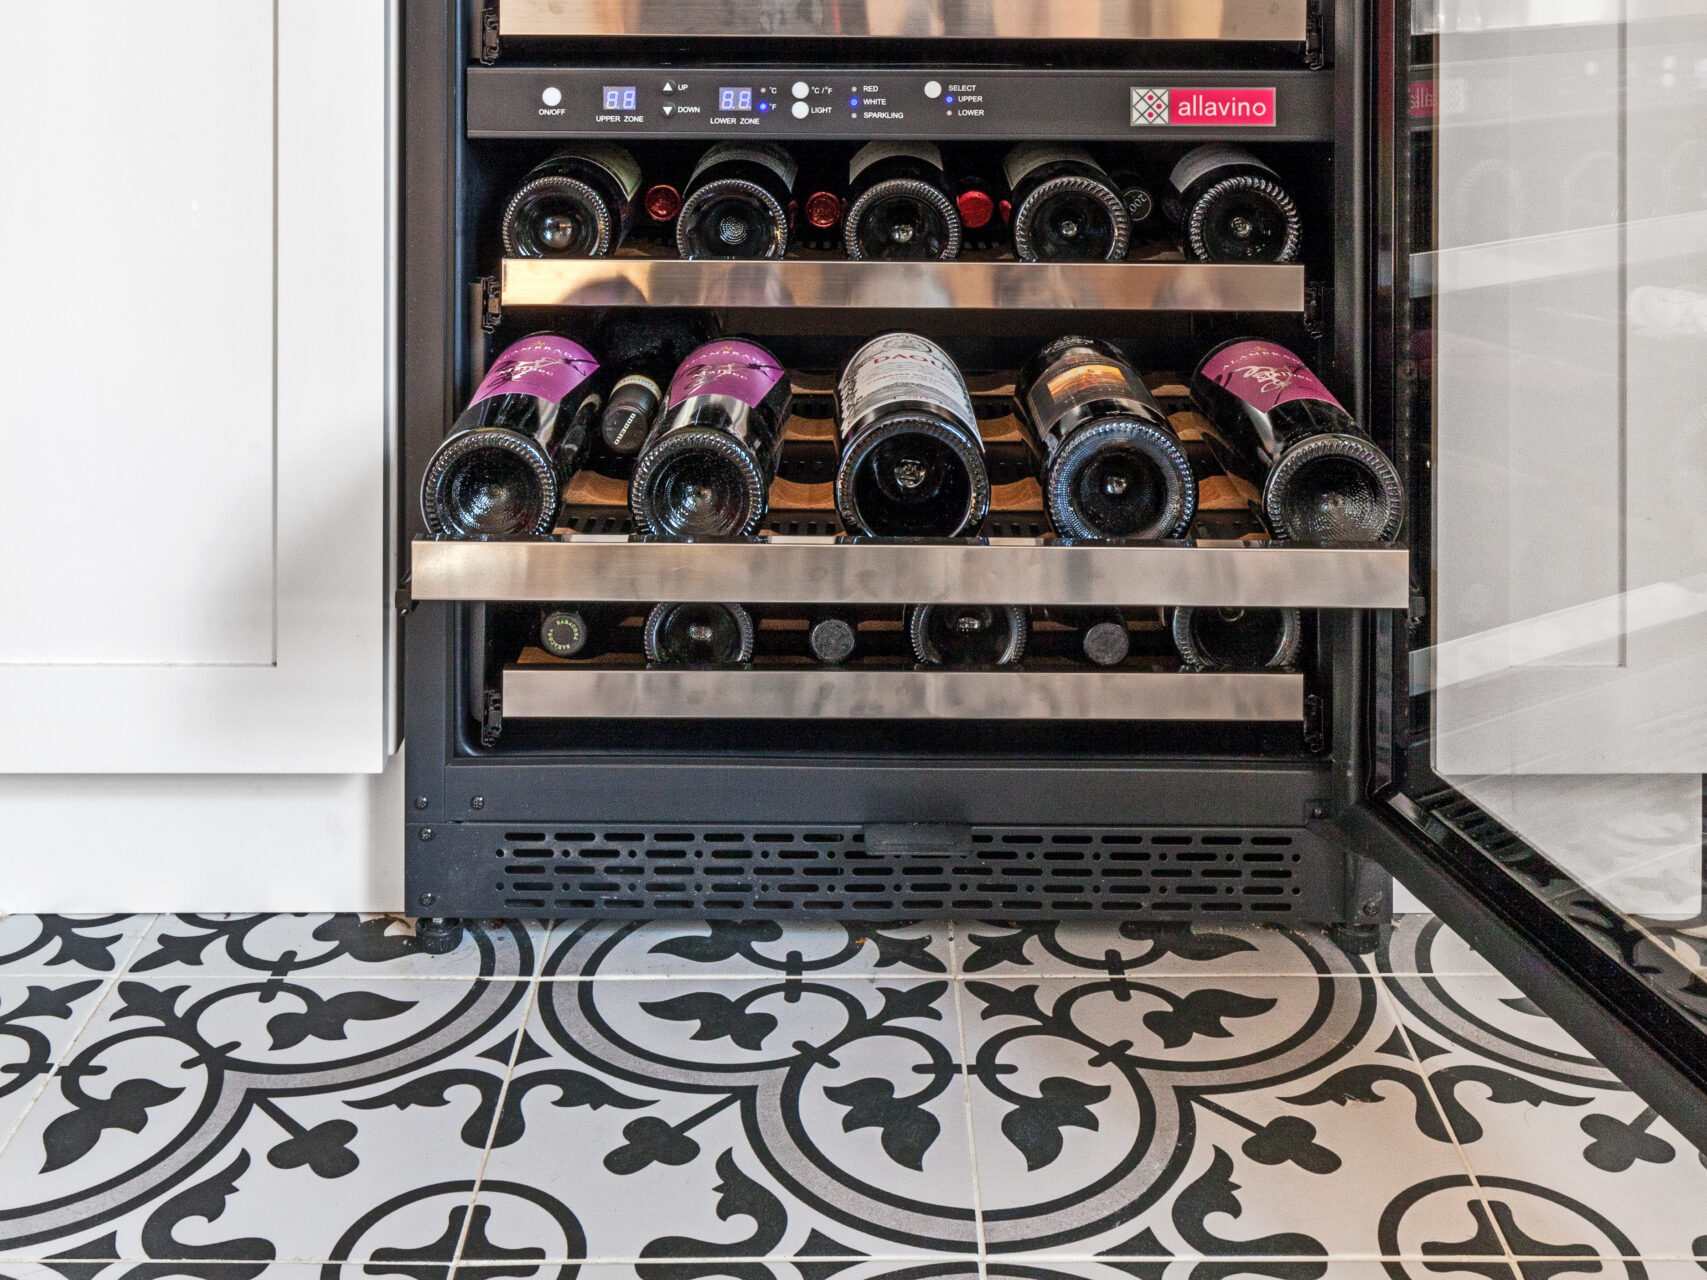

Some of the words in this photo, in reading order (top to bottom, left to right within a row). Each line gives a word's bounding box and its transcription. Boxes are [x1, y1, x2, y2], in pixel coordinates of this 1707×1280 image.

[863, 85, 879, 93] RED
[863, 98, 887, 106] WHITE
[1178, 94, 1266, 117] allavino
[538, 108, 566, 116] ON/OFF
[957, 109, 985, 117] LOWER
[595, 115, 621, 123] UPPER
[623, 115, 645, 123] ZONE
[710, 117, 737, 125] LOWER
[740, 117, 760, 125] ZONE
